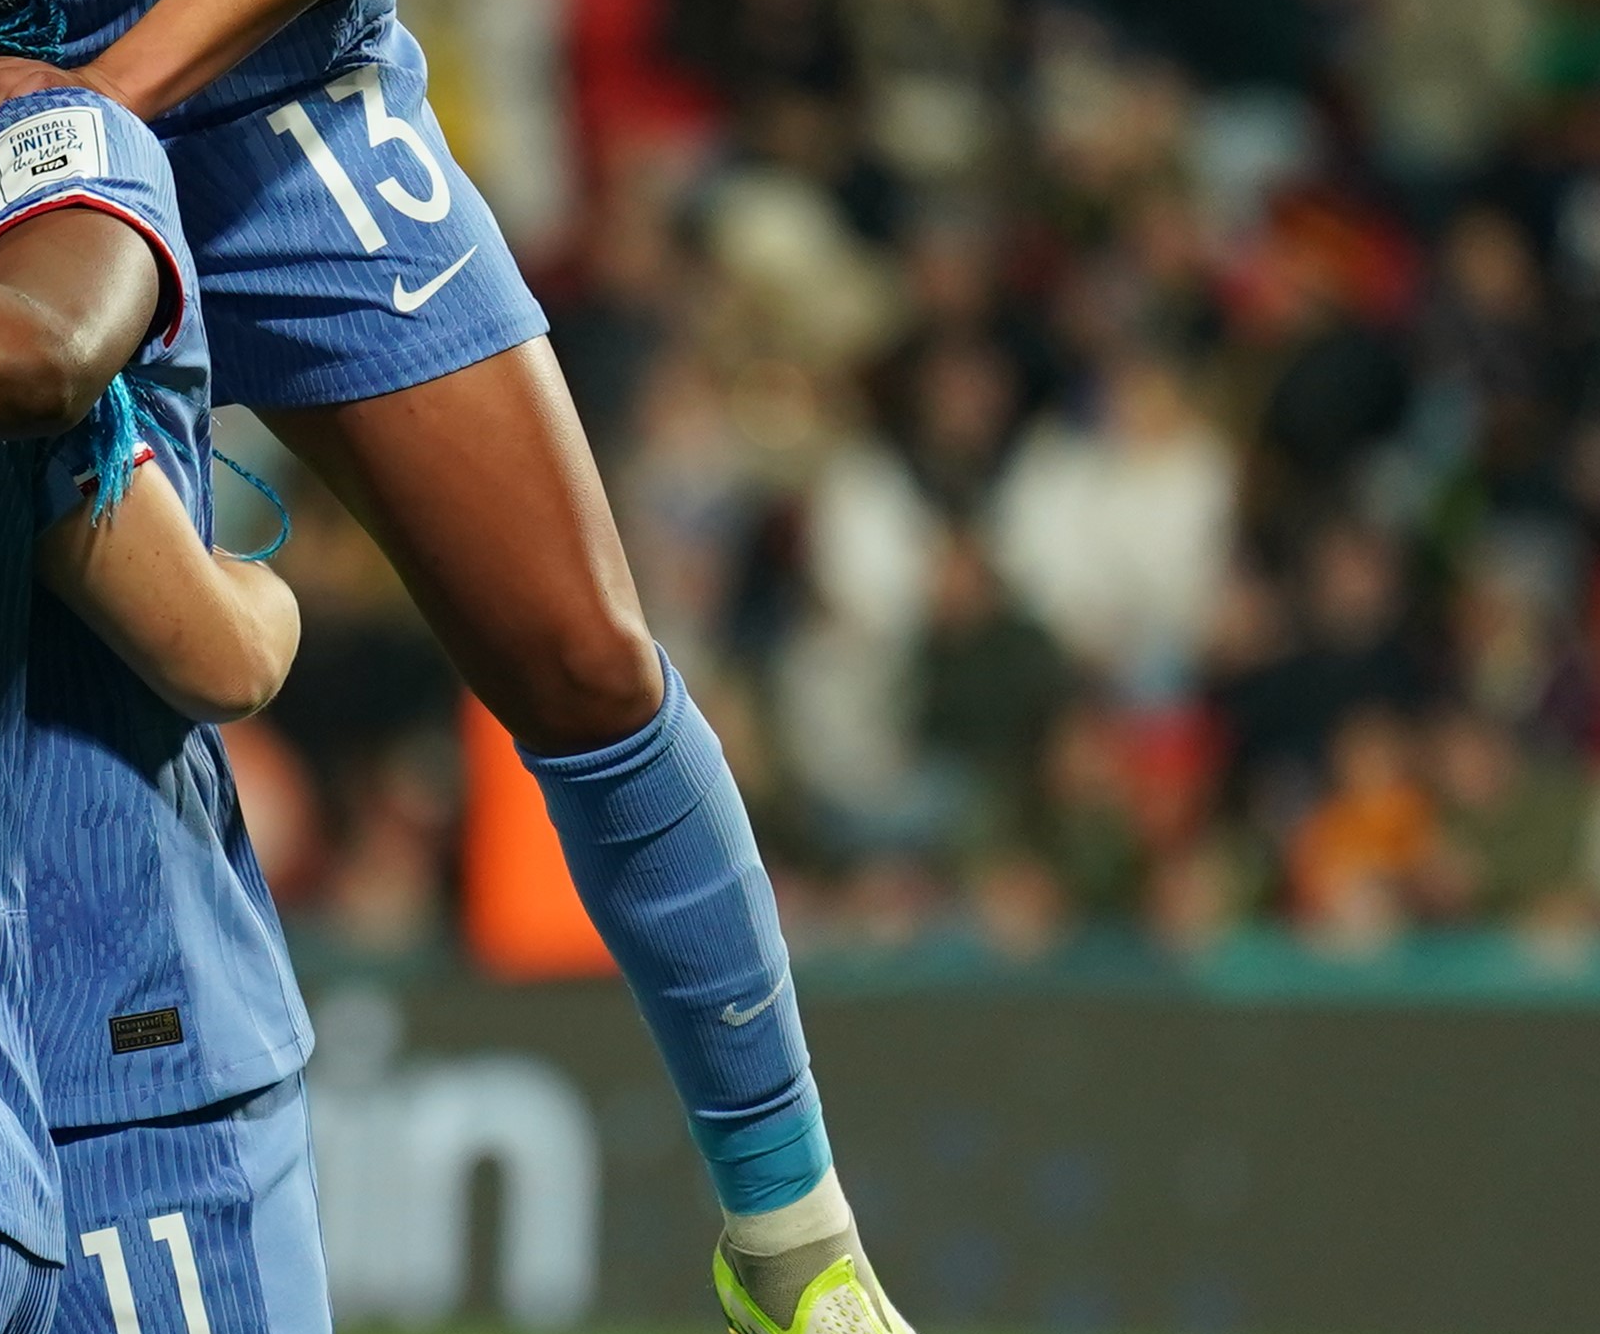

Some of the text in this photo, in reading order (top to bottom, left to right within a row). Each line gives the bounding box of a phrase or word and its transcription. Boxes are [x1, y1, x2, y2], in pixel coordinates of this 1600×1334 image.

[9, 119, 76, 144] FOOTBALL
[12, 129, 77, 158] UNITES
[12, 140, 83, 173] the World
[35, 158, 66, 174] FIFA
[266, 65, 451, 254] 13
